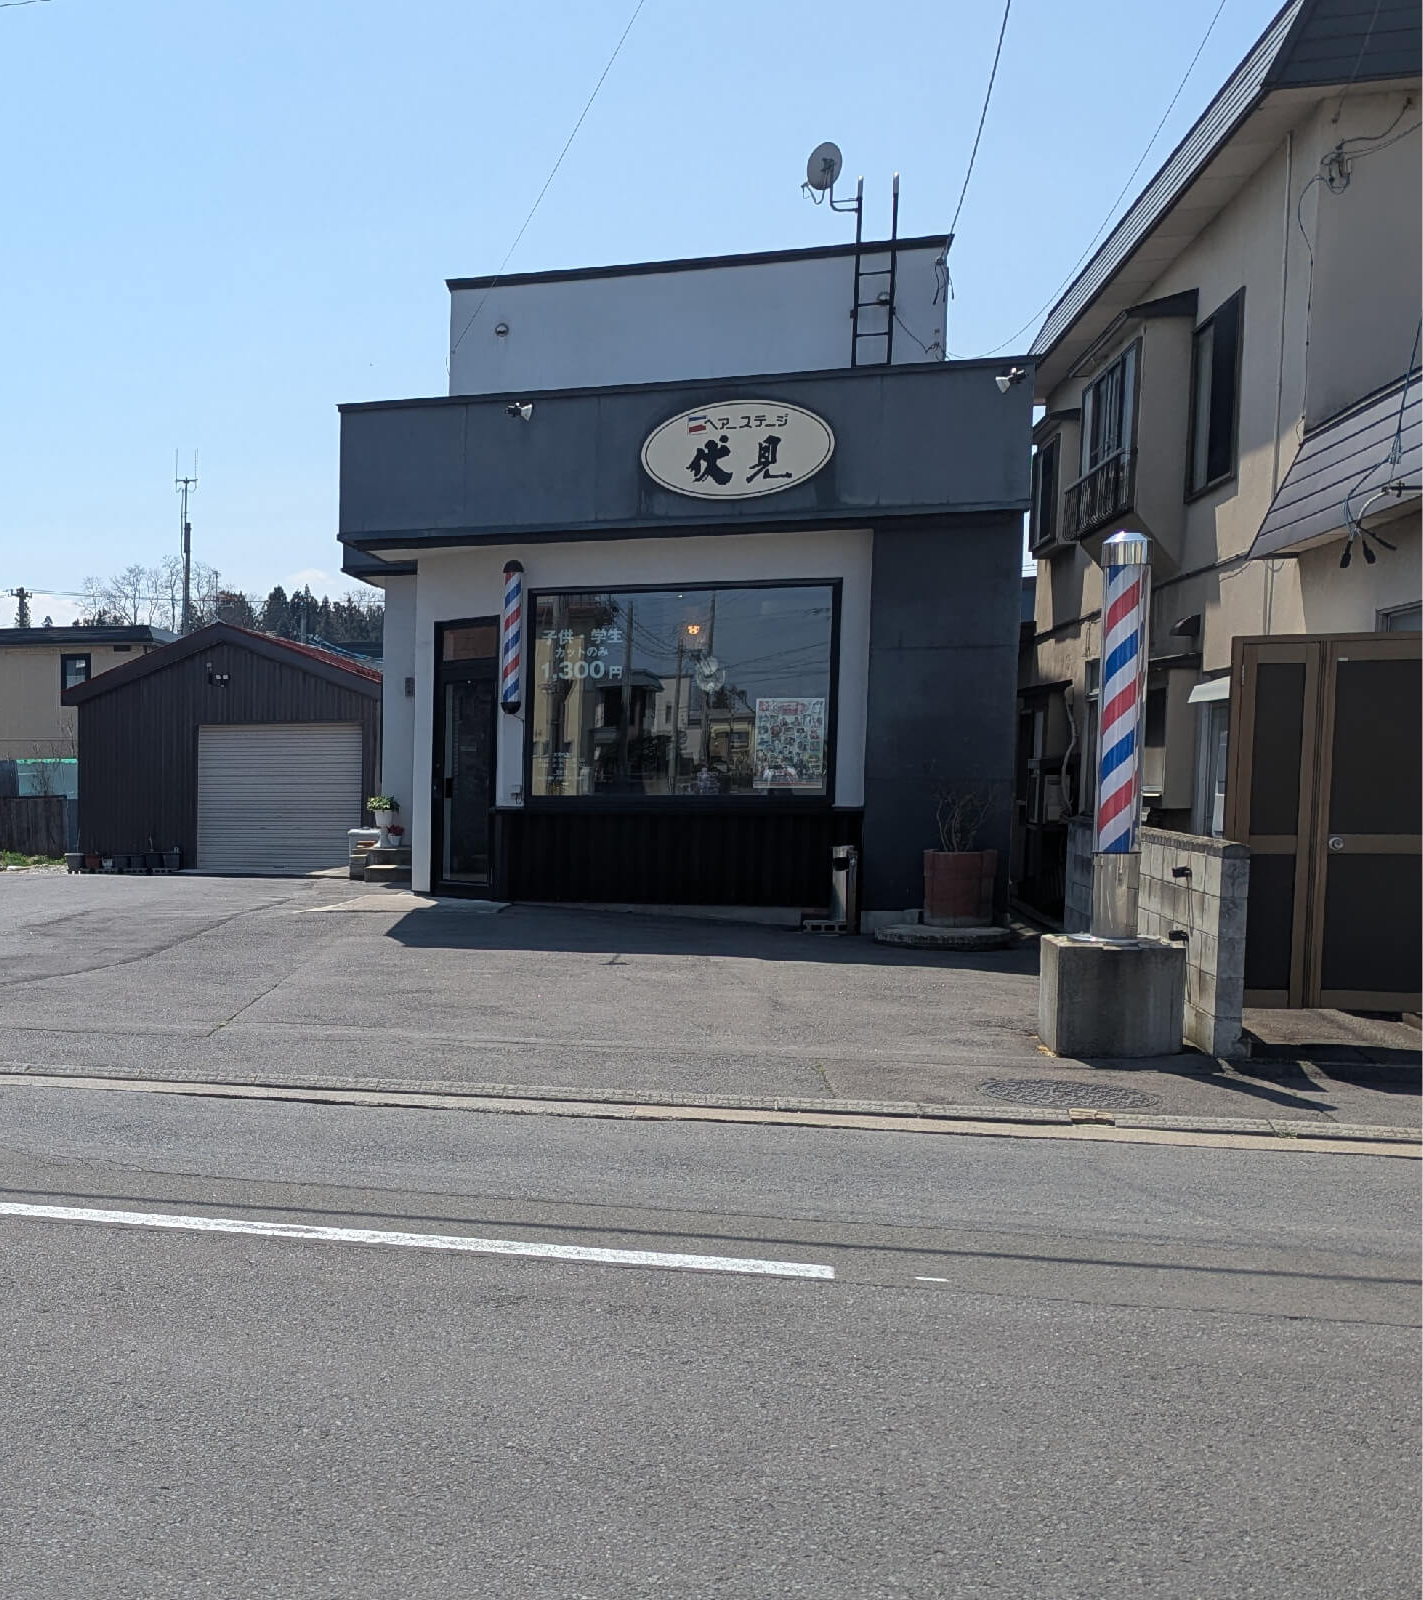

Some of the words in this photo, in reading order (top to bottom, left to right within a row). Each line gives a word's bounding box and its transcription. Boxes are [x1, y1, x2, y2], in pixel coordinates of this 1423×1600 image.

[704, 413, 789, 430] ヘアーステージ
[685, 434, 793, 485] 伏見
[541, 628, 624, 646] 子供・学生
[555, 646, 609, 658] カットのみ
